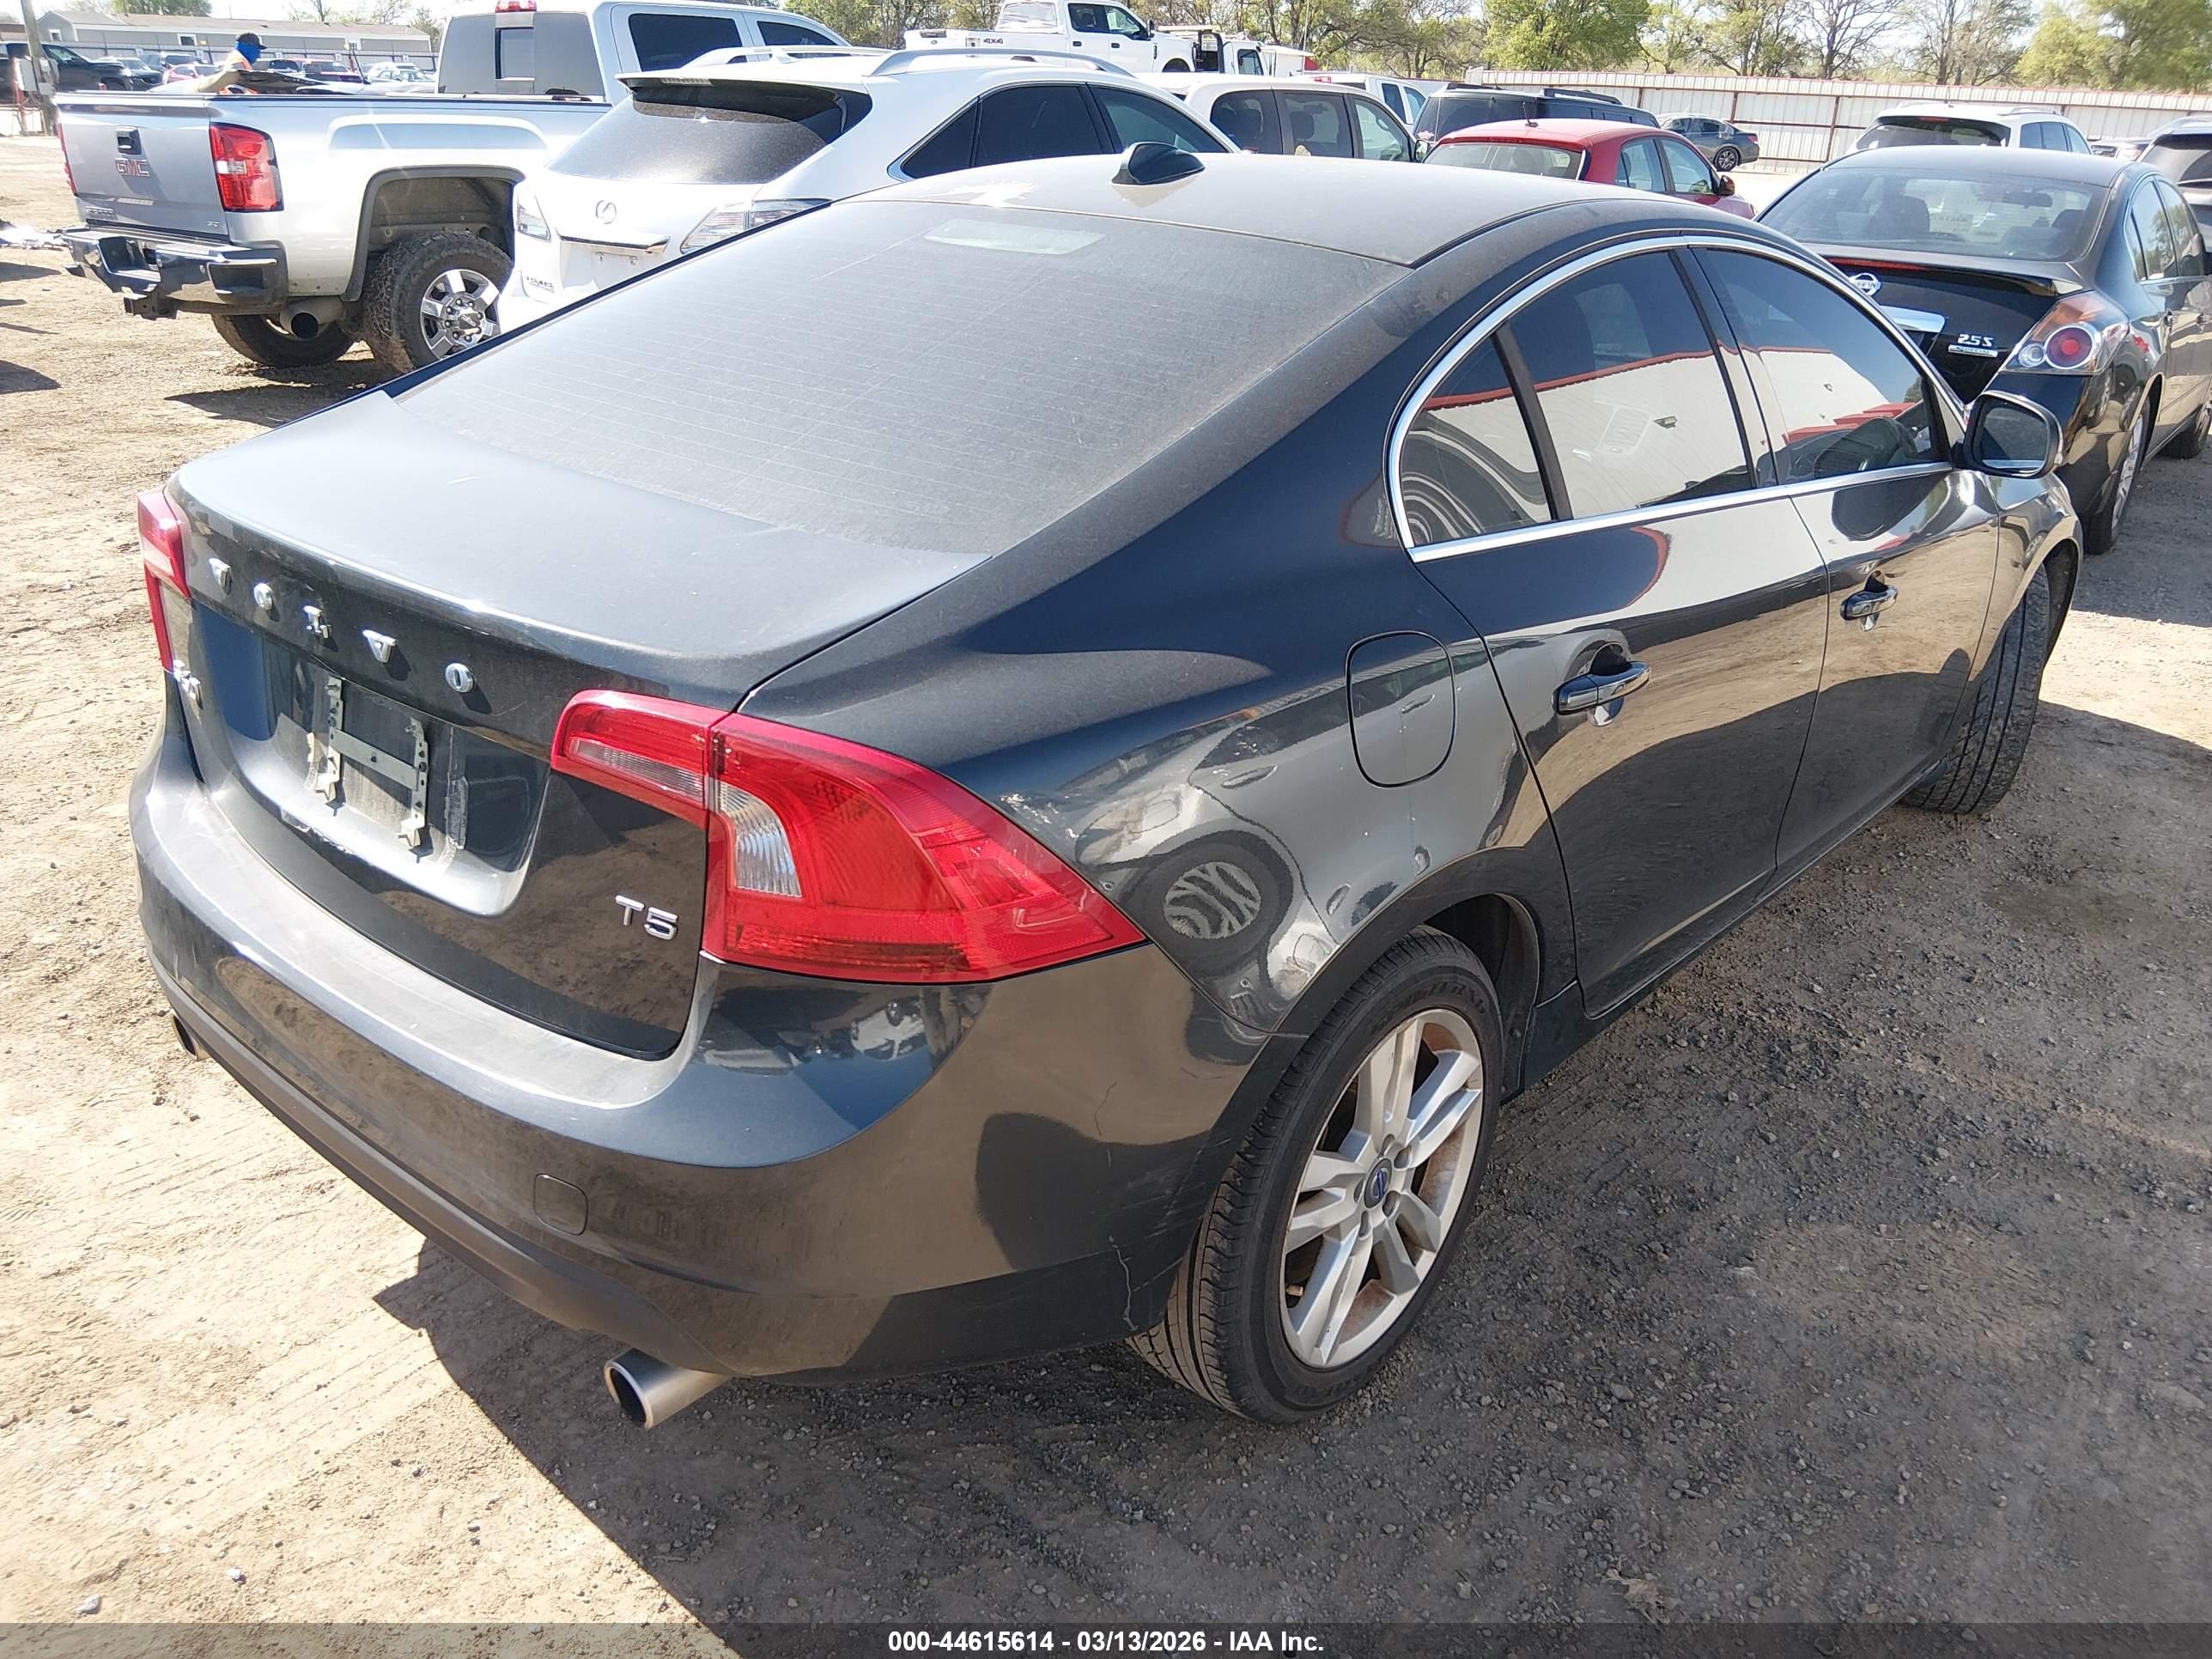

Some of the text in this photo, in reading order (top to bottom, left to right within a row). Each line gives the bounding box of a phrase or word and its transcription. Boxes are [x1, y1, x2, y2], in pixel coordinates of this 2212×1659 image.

[115, 158, 150, 177] GMC
[209, 558, 476, 694] VOLVO
[615, 895, 678, 940] T5
